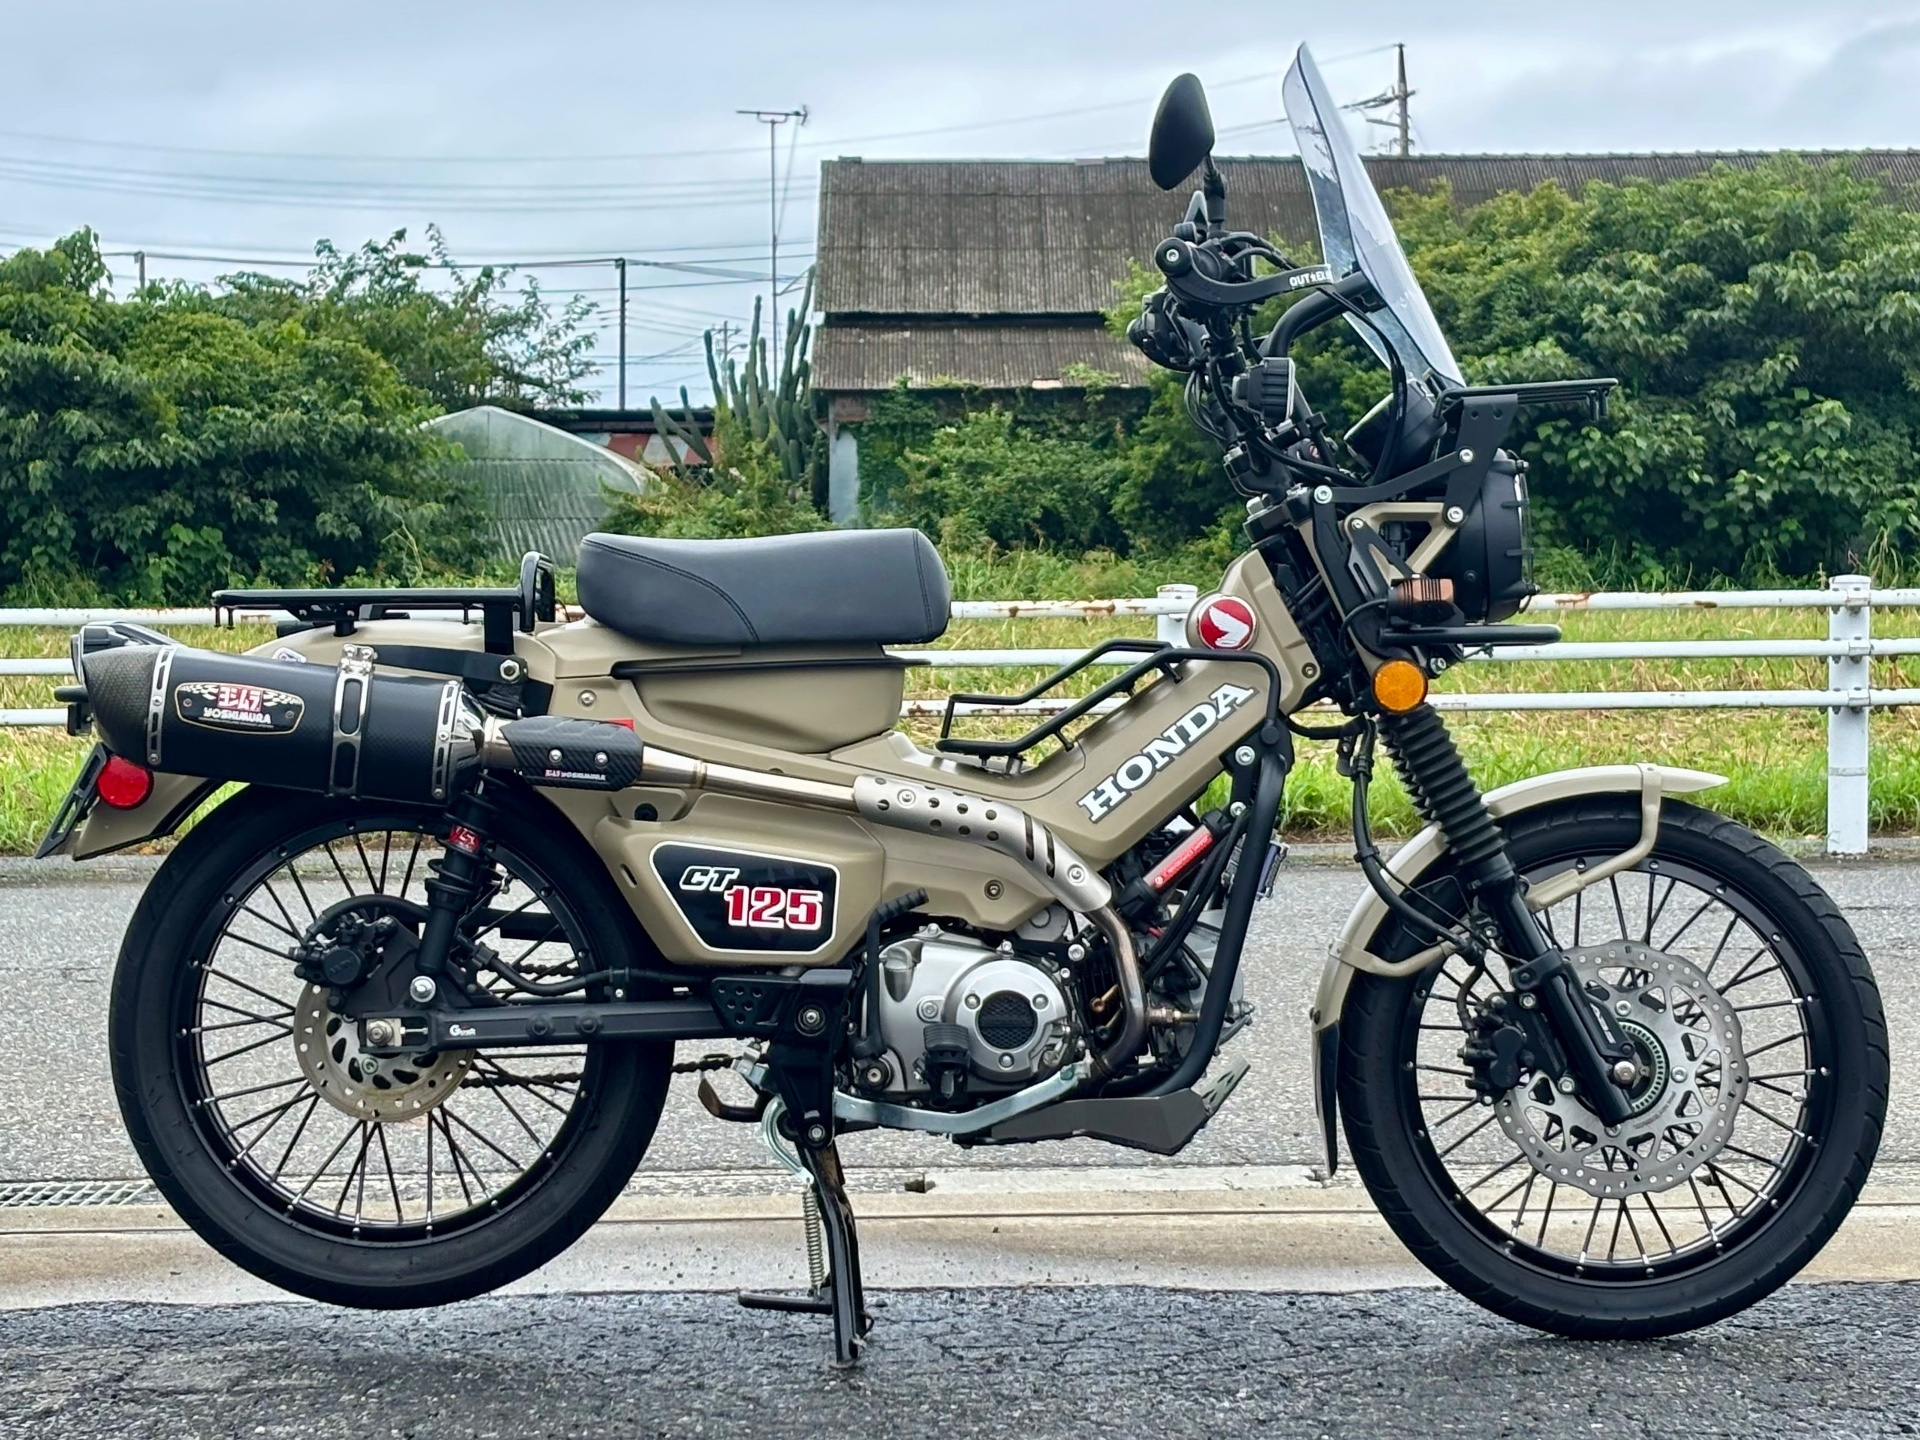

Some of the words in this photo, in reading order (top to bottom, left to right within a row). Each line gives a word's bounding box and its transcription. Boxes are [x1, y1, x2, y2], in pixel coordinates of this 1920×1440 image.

[203, 706, 272, 724] YOSHIMURA
[1078, 683, 1257, 823] HONDA
[679, 865, 740, 892] CT
[724, 885, 823, 931] 125
